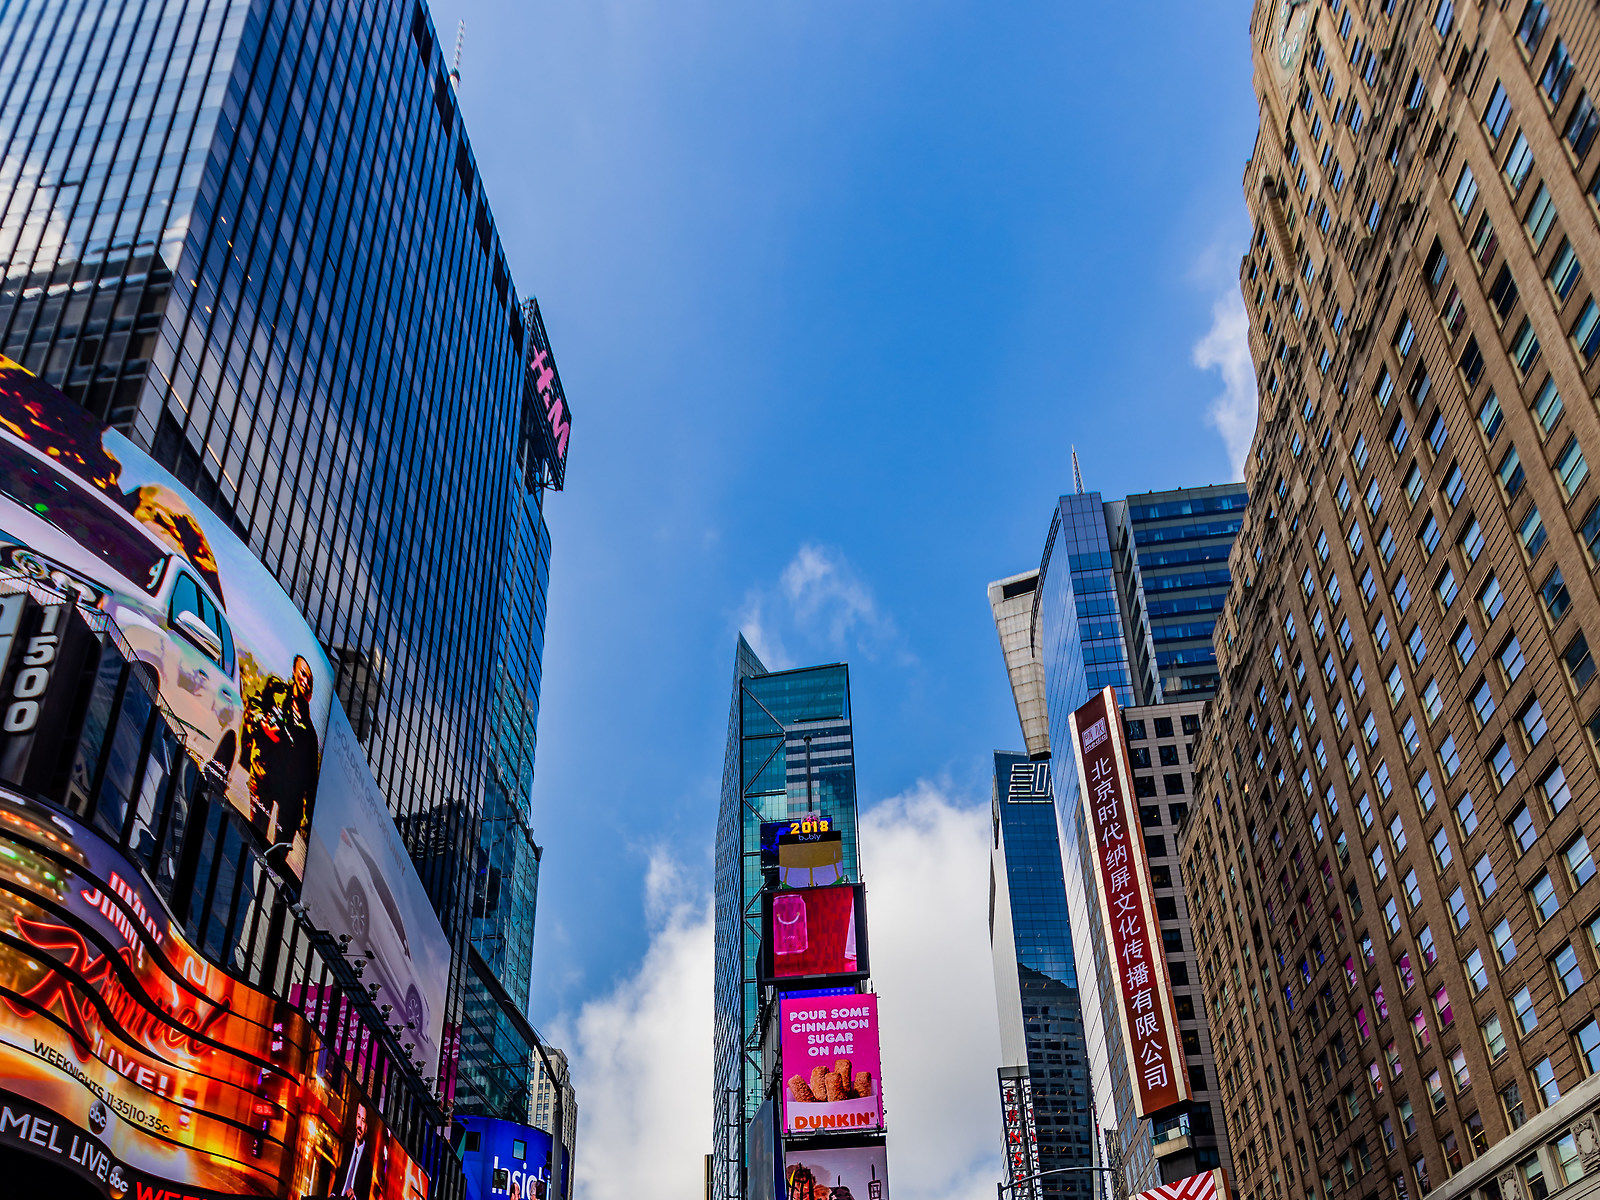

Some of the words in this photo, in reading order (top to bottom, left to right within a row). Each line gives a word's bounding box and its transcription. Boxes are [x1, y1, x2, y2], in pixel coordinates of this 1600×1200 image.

[4, 607, 60, 733] 1500
[790, 820, 828, 834] 2018
[1090, 757, 1169, 1091] 北京时代纳屏文化传播有限公司
[789, 1010, 827, 1022] POUR
[831, 1007, 870, 1019] SOME
[790, 1019, 869, 1033] CINNAMON
[807, 1032, 854, 1045] SUGAR
[808, 1045, 831, 1056] ON
[834, 1044, 854, 1055] ME
[32, 1038, 105, 1098] WEEKNIGHTS
[89, 1105, 106, 1128] abc
[794, 1112, 876, 1130] DUNKIN'
[0, 1106, 63, 1154] MEL
[69, 1134, 110, 1183] LIVE!
[109, 1167, 129, 1195] abc
